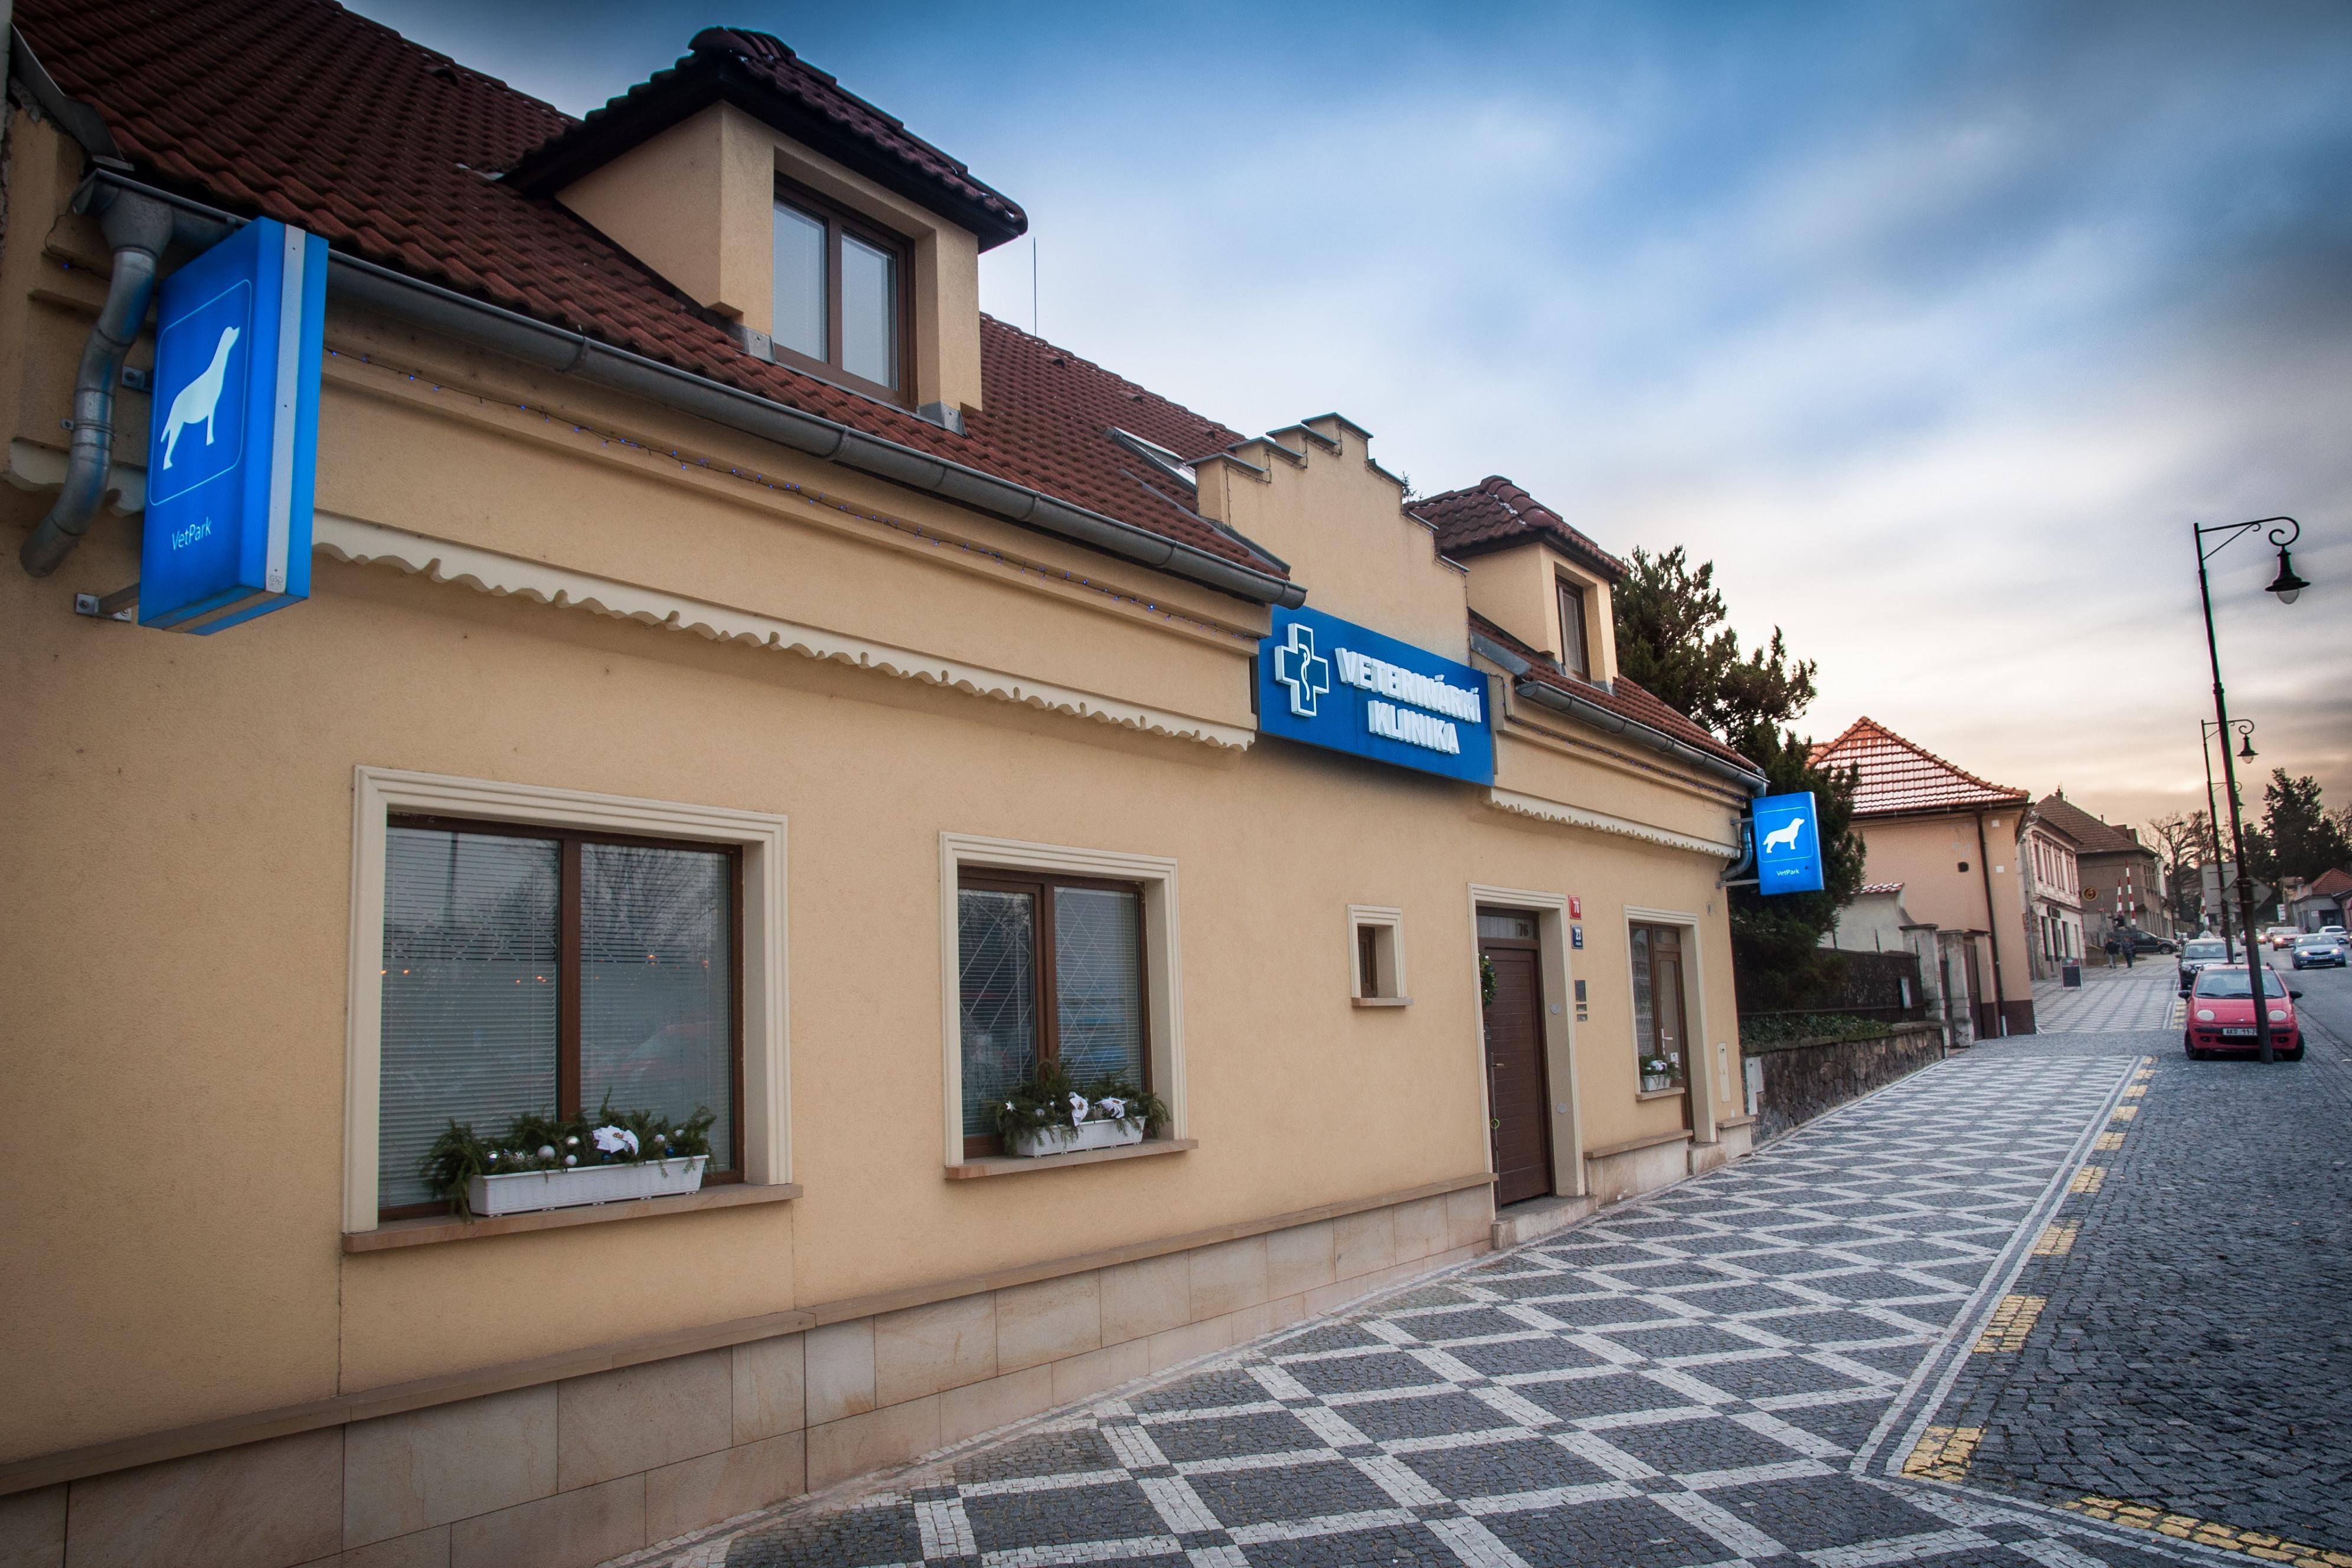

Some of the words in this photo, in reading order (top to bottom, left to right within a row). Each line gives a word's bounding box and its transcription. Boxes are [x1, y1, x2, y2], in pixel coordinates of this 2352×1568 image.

[171, 516, 211, 550] VetPark
[1335, 648, 1481, 723] VETERINÁRNÍ
[1367, 700, 1461, 754] KLINIKA
[1575, 929, 1582, 940] 23
